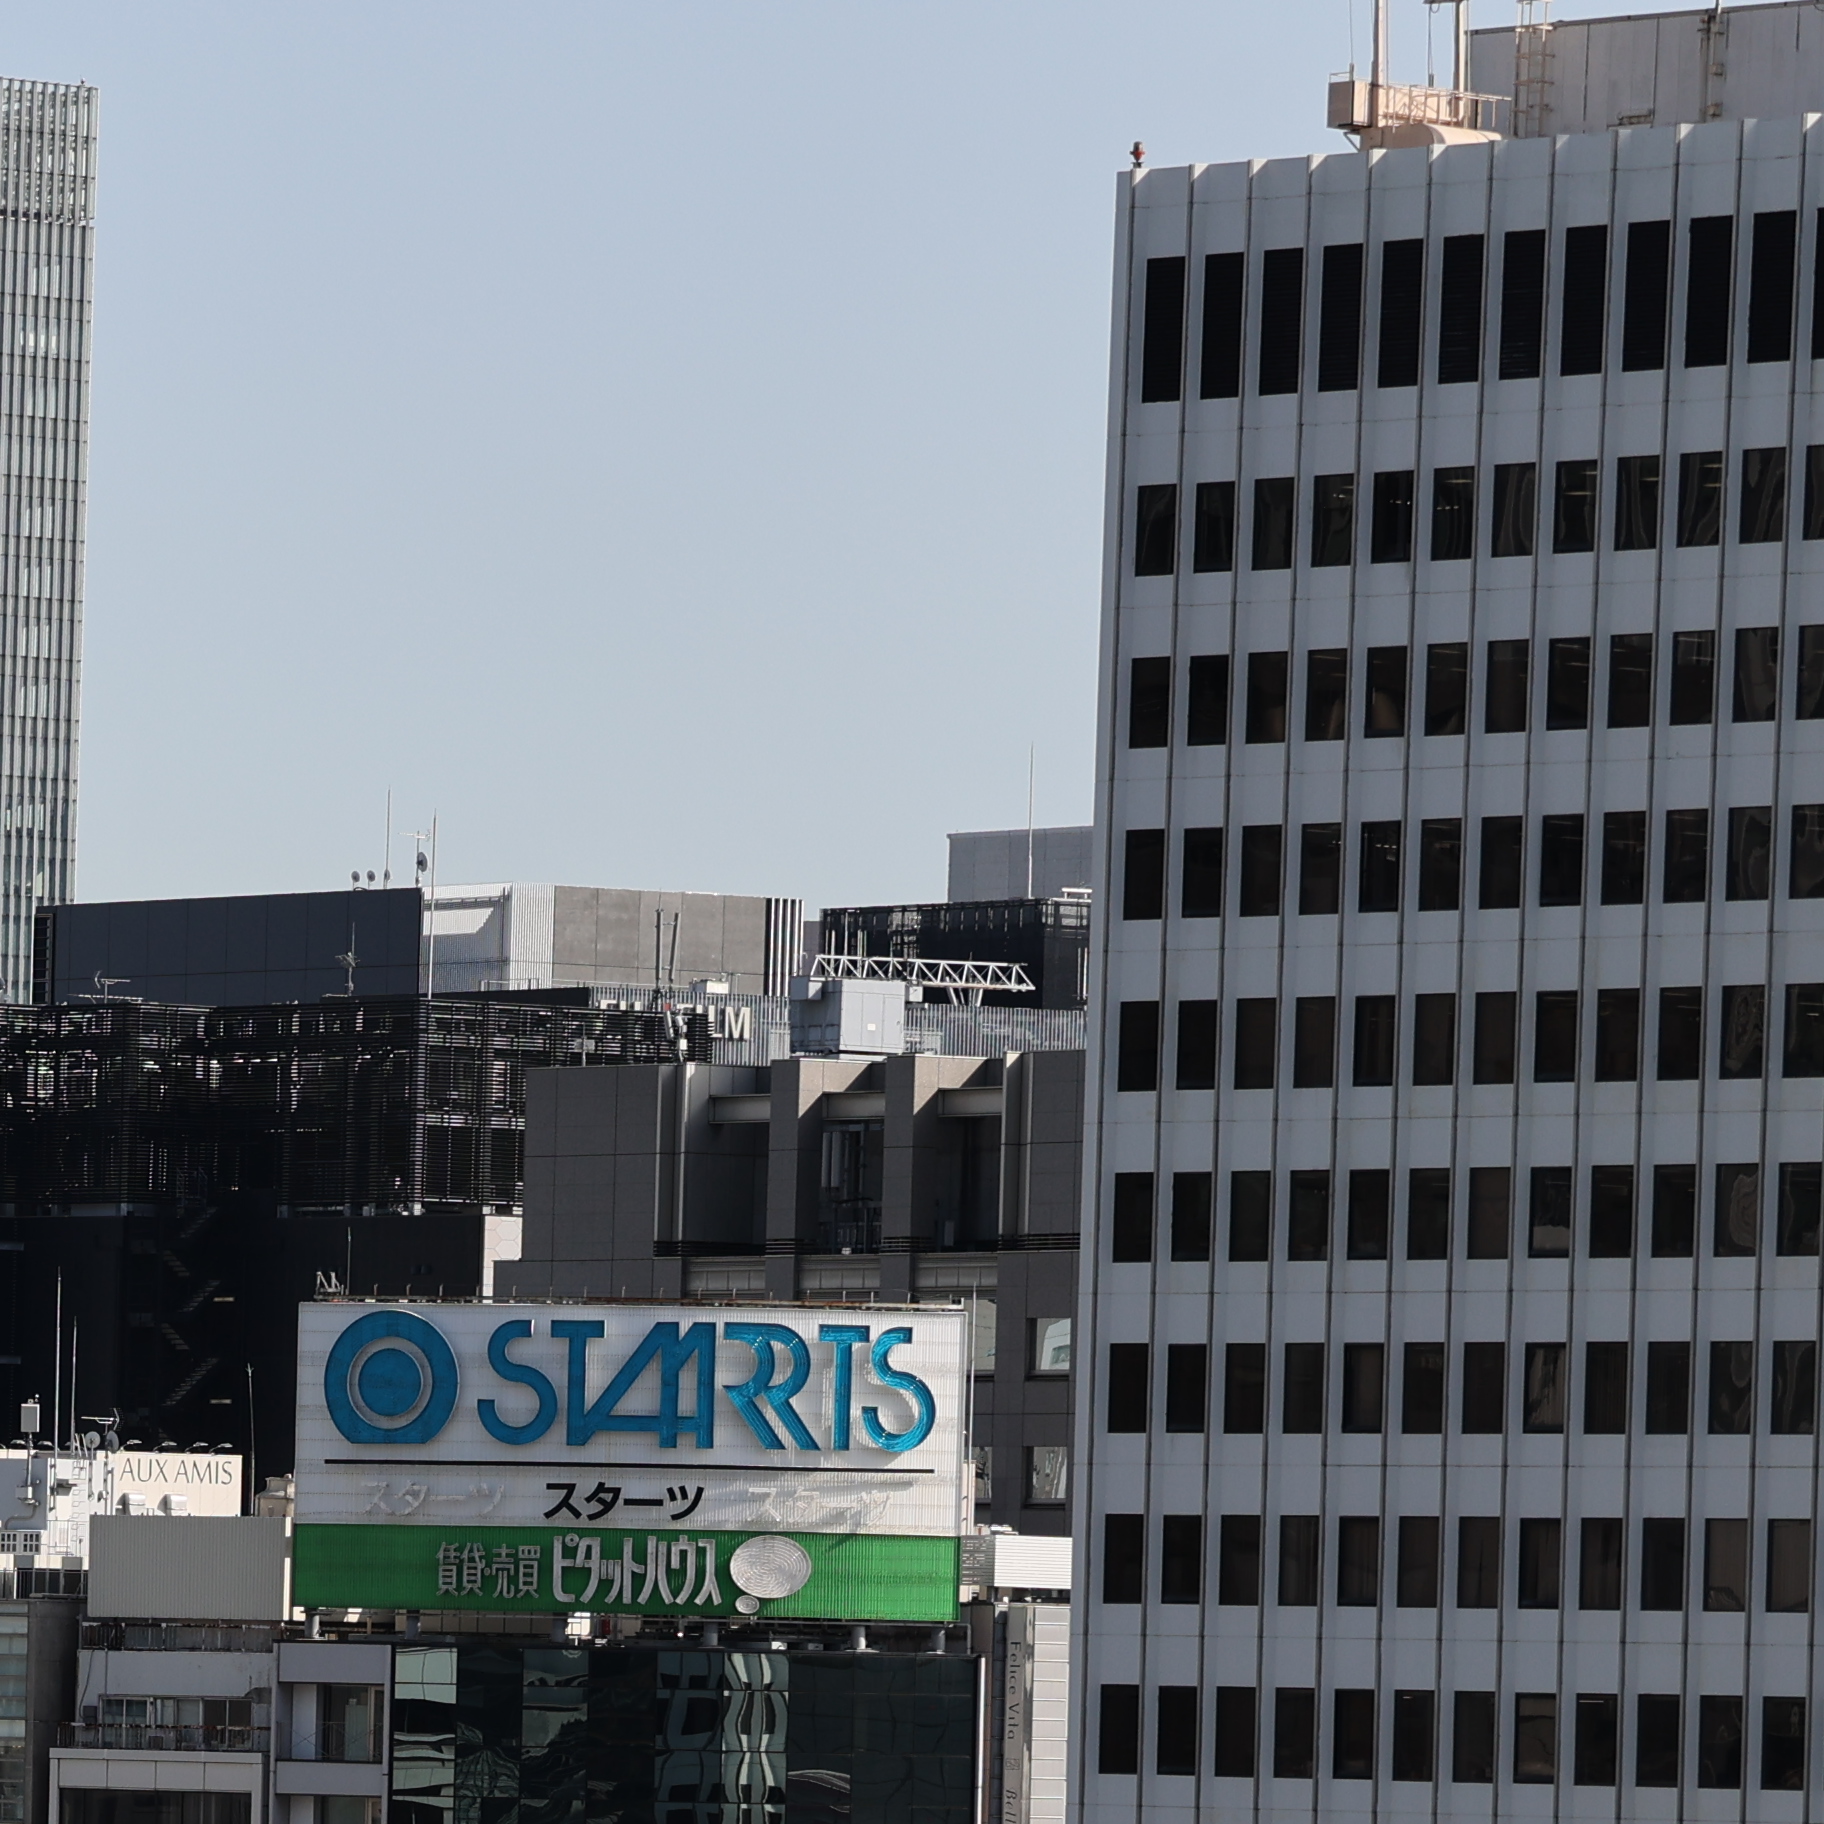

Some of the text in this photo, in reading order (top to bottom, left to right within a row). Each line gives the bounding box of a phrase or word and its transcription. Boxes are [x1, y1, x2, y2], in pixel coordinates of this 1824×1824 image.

[477, 1319, 936, 1453] STARTS
[119, 1457, 233, 1485] AUX AMIS
[542, 1481, 705, 1522] スターツ
[552, 1532, 723, 1607] ピタットハウス
[1007, 1641, 1021, 1740] Felice Vita
